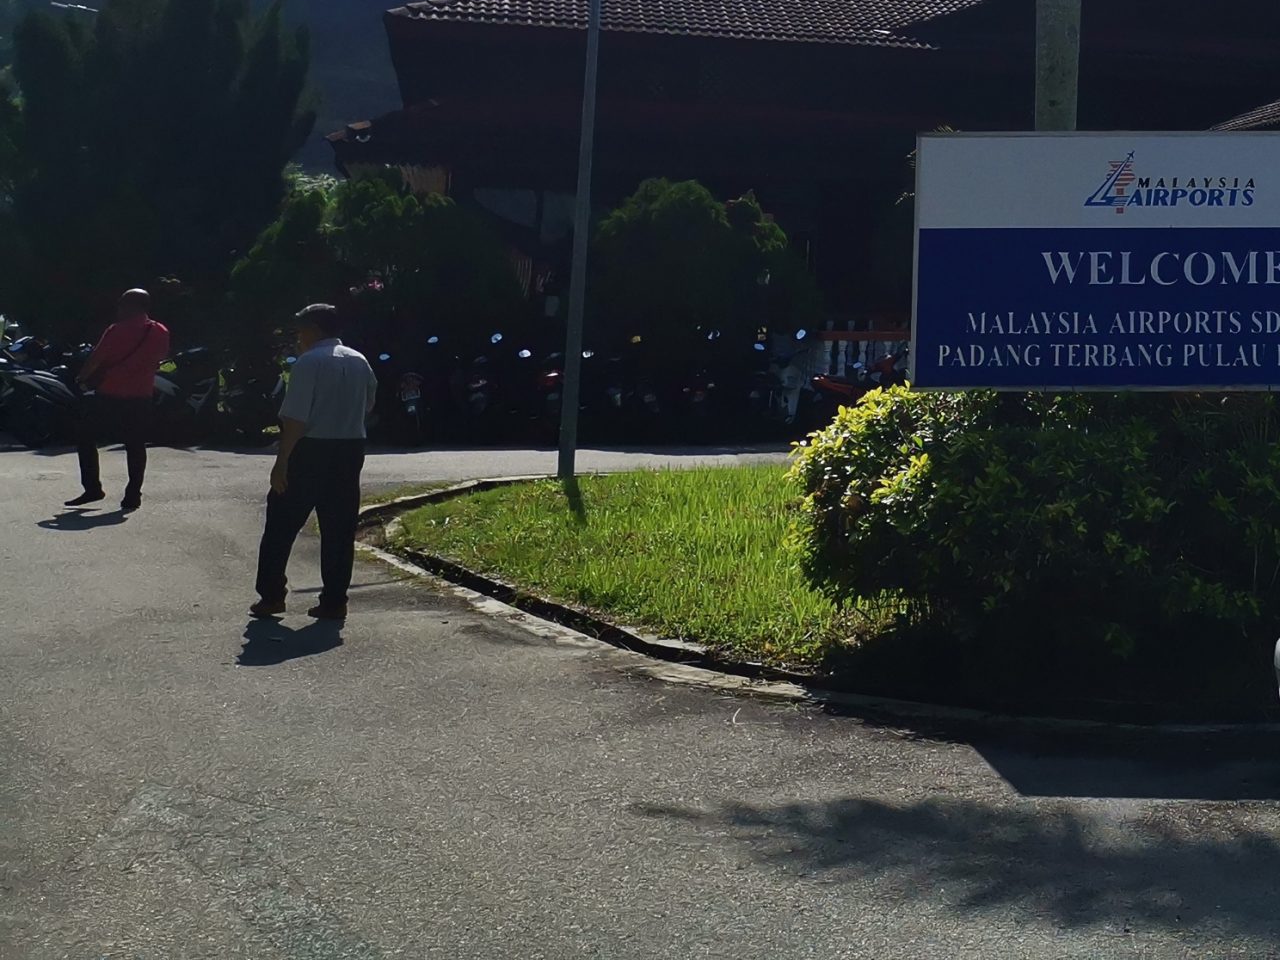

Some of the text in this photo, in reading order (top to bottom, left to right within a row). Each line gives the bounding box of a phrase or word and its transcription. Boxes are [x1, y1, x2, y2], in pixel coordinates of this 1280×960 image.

[1137, 177, 1256, 189] MALAYSIA
[1127, 188, 1254, 207] AIRPORTS
[966, 311, 1098, 335] MALAYSIA
[1109, 311, 1241, 335] AIRPORTS
[938, 344, 1041, 368] PADANG
[1050, 344, 1173, 368] TERBANG
[1182, 343, 1264, 368] PULAU
